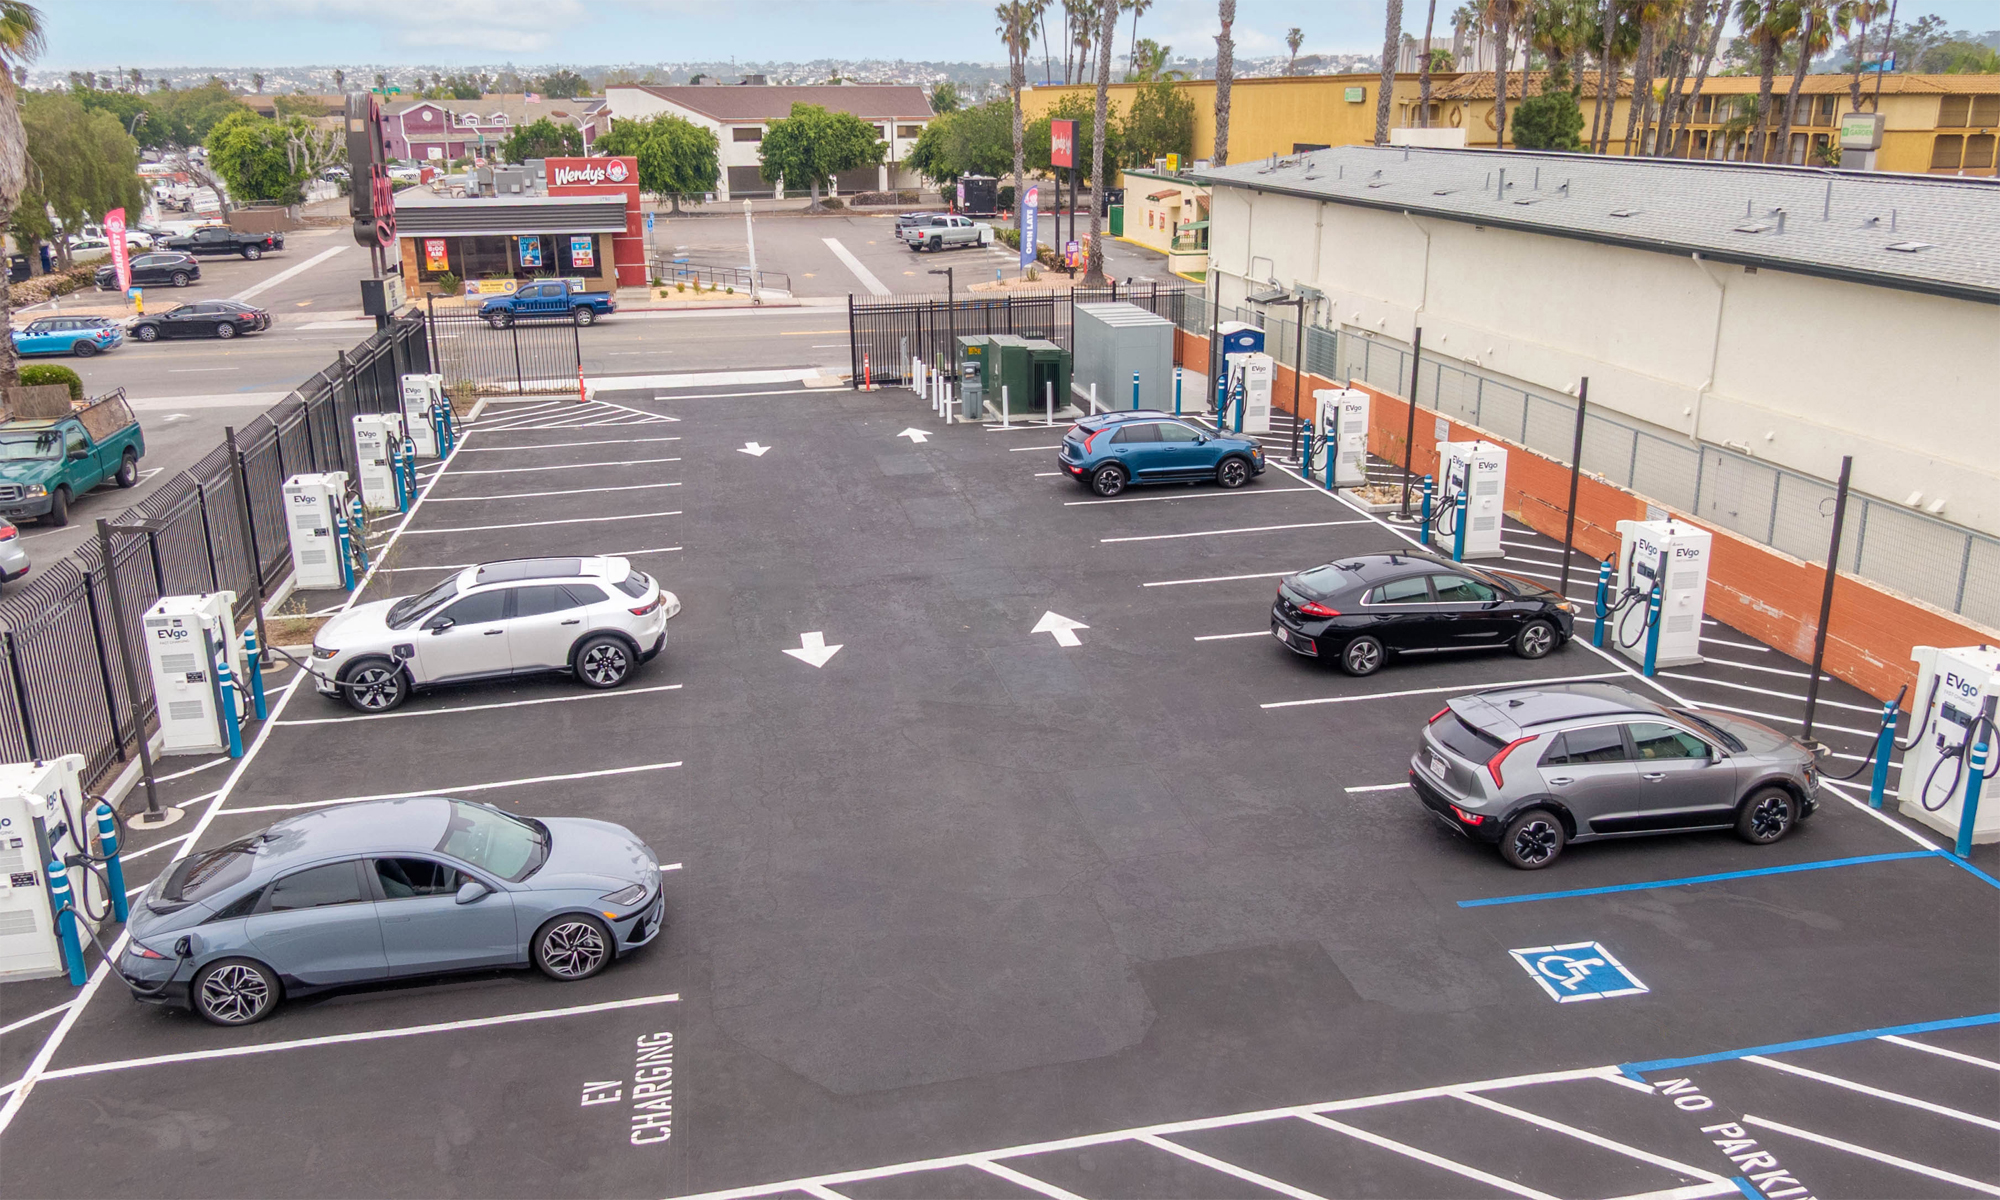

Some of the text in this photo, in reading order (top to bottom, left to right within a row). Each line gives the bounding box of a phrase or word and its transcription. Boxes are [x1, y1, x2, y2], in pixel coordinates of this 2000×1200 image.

[555, 164, 606, 186] Wendy's
[1026, 209, 1034, 254] OPEN LATE
[113, 233, 126, 286] BREAKFAST
[1478, 461, 1498, 470] EVgo
[294, 495, 317, 504] EVgo
[1639, 538, 1658, 555] EVgo
[1677, 548, 1700, 558] EVgo
[157, 629, 188, 640] EVgo
[1946, 672, 1978, 697] EVgo
[581, 1081, 622, 1106] EV
[631, 1032, 673, 1145] CHARGING
[1653, 1077, 1819, 1200] NO PARKI
